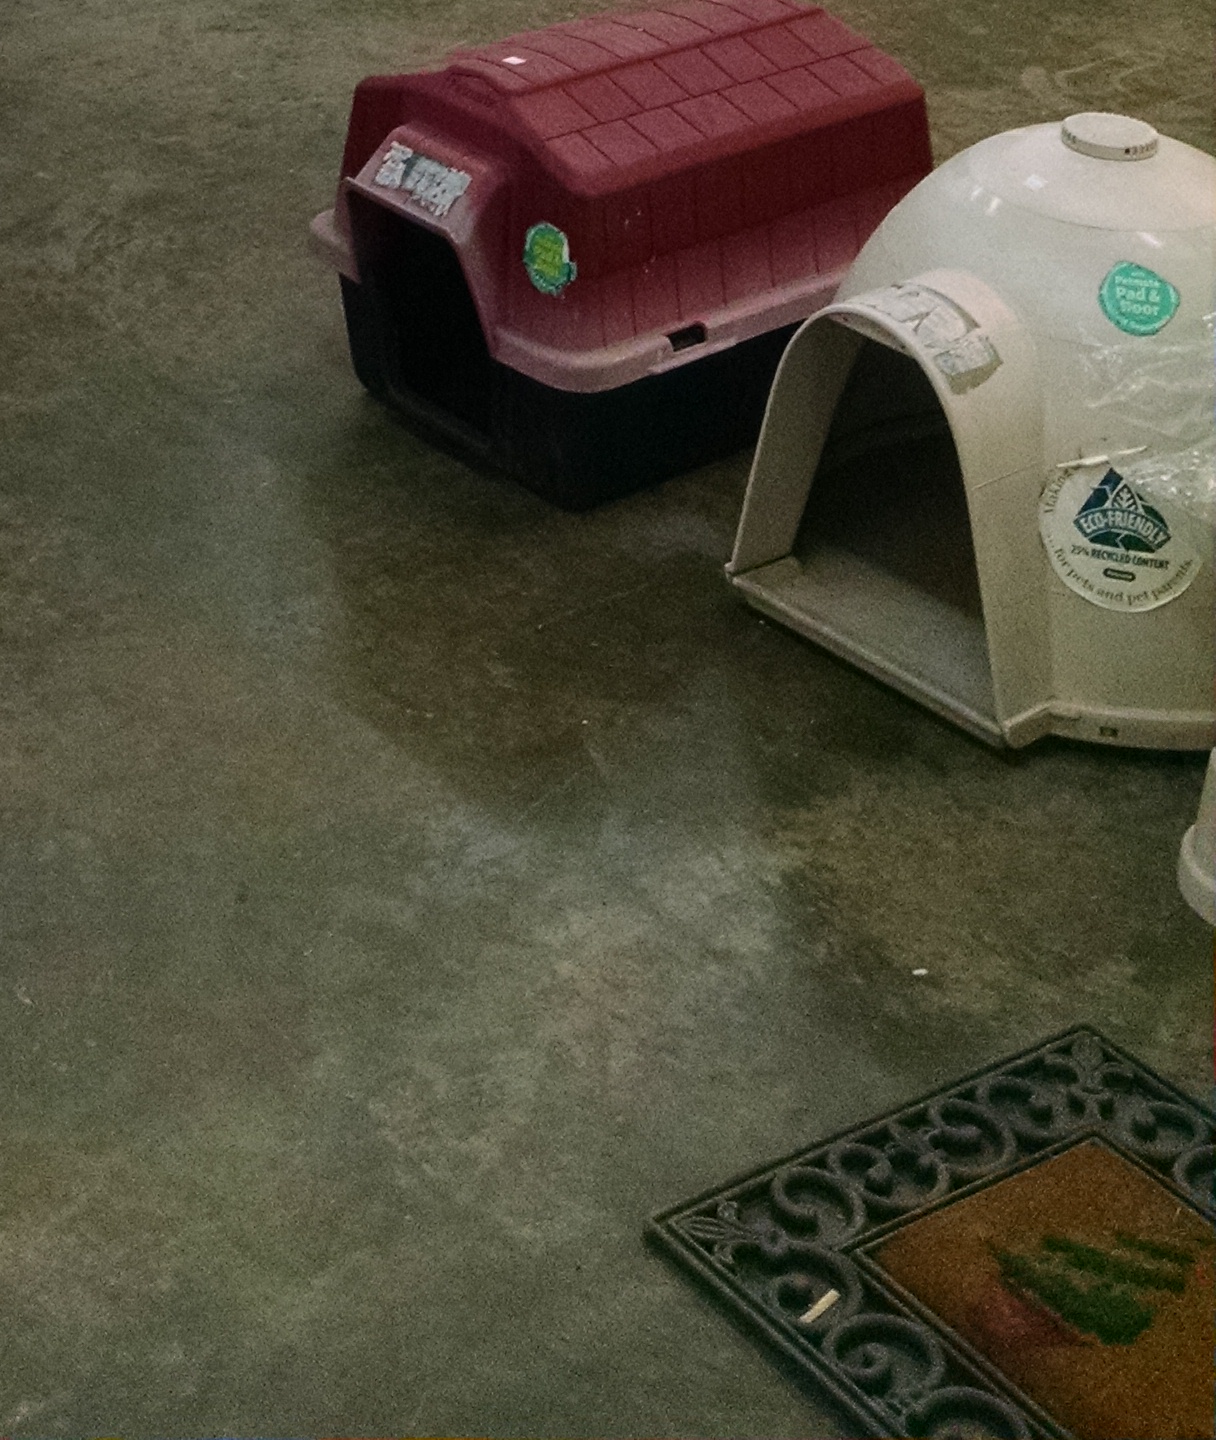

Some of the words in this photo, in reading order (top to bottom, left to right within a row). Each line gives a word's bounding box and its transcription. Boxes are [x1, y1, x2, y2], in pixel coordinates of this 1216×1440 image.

[1116, 285, 1147, 301] Pad
[1079, 511, 1168, 545] ECO-FRIENDLY
[1090, 548, 1132, 565] RECYCLED
[1131, 554, 1170, 571] CONTENT
